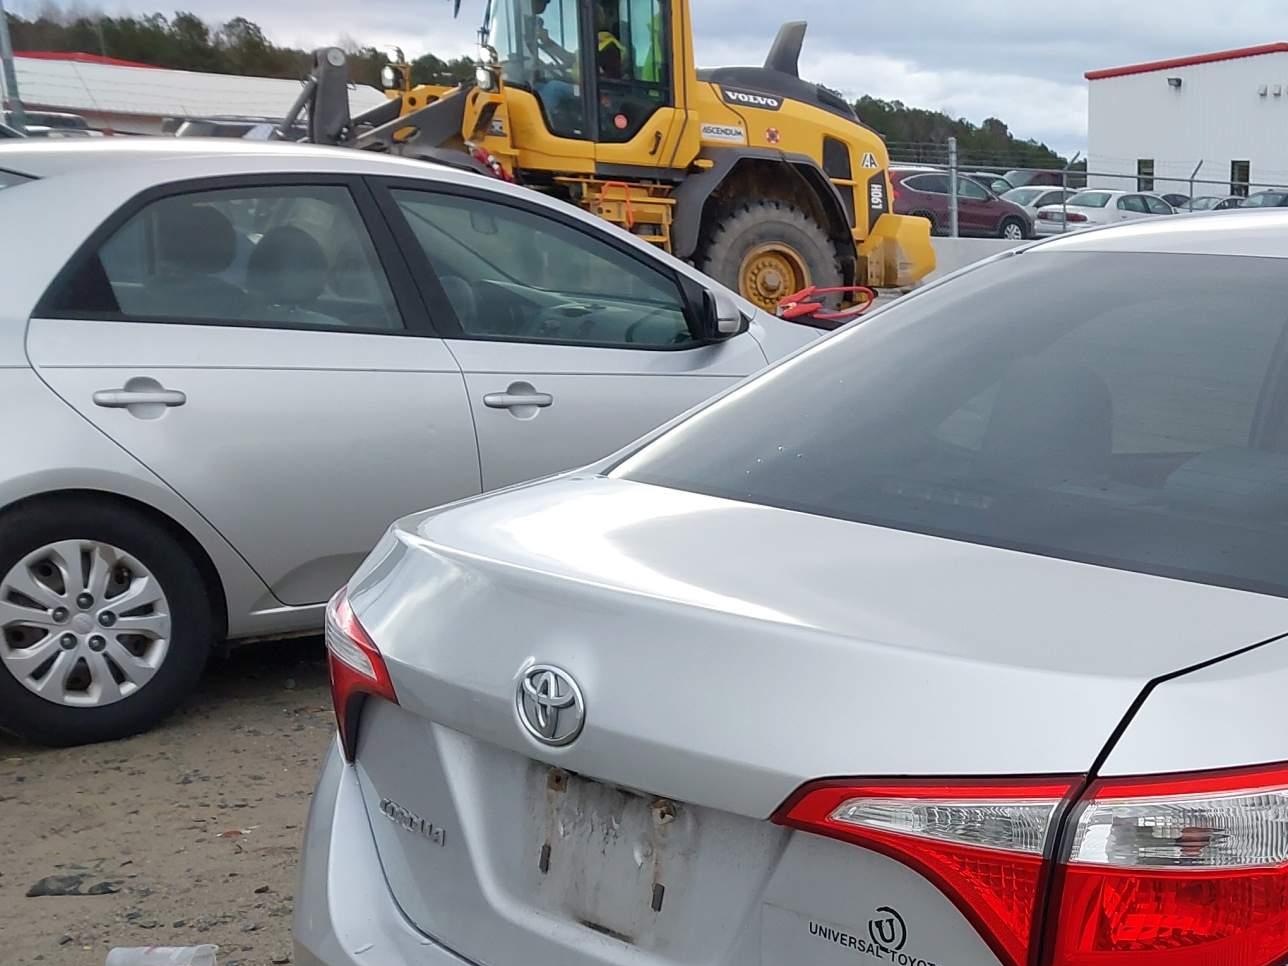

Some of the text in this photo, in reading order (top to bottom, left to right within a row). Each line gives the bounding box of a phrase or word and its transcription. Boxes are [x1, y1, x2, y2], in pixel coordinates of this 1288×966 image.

[725, 90, 778, 107] VOLVO
[870, 184, 883, 209] L90H
[809, 921, 884, 959] UNIVERSAL
